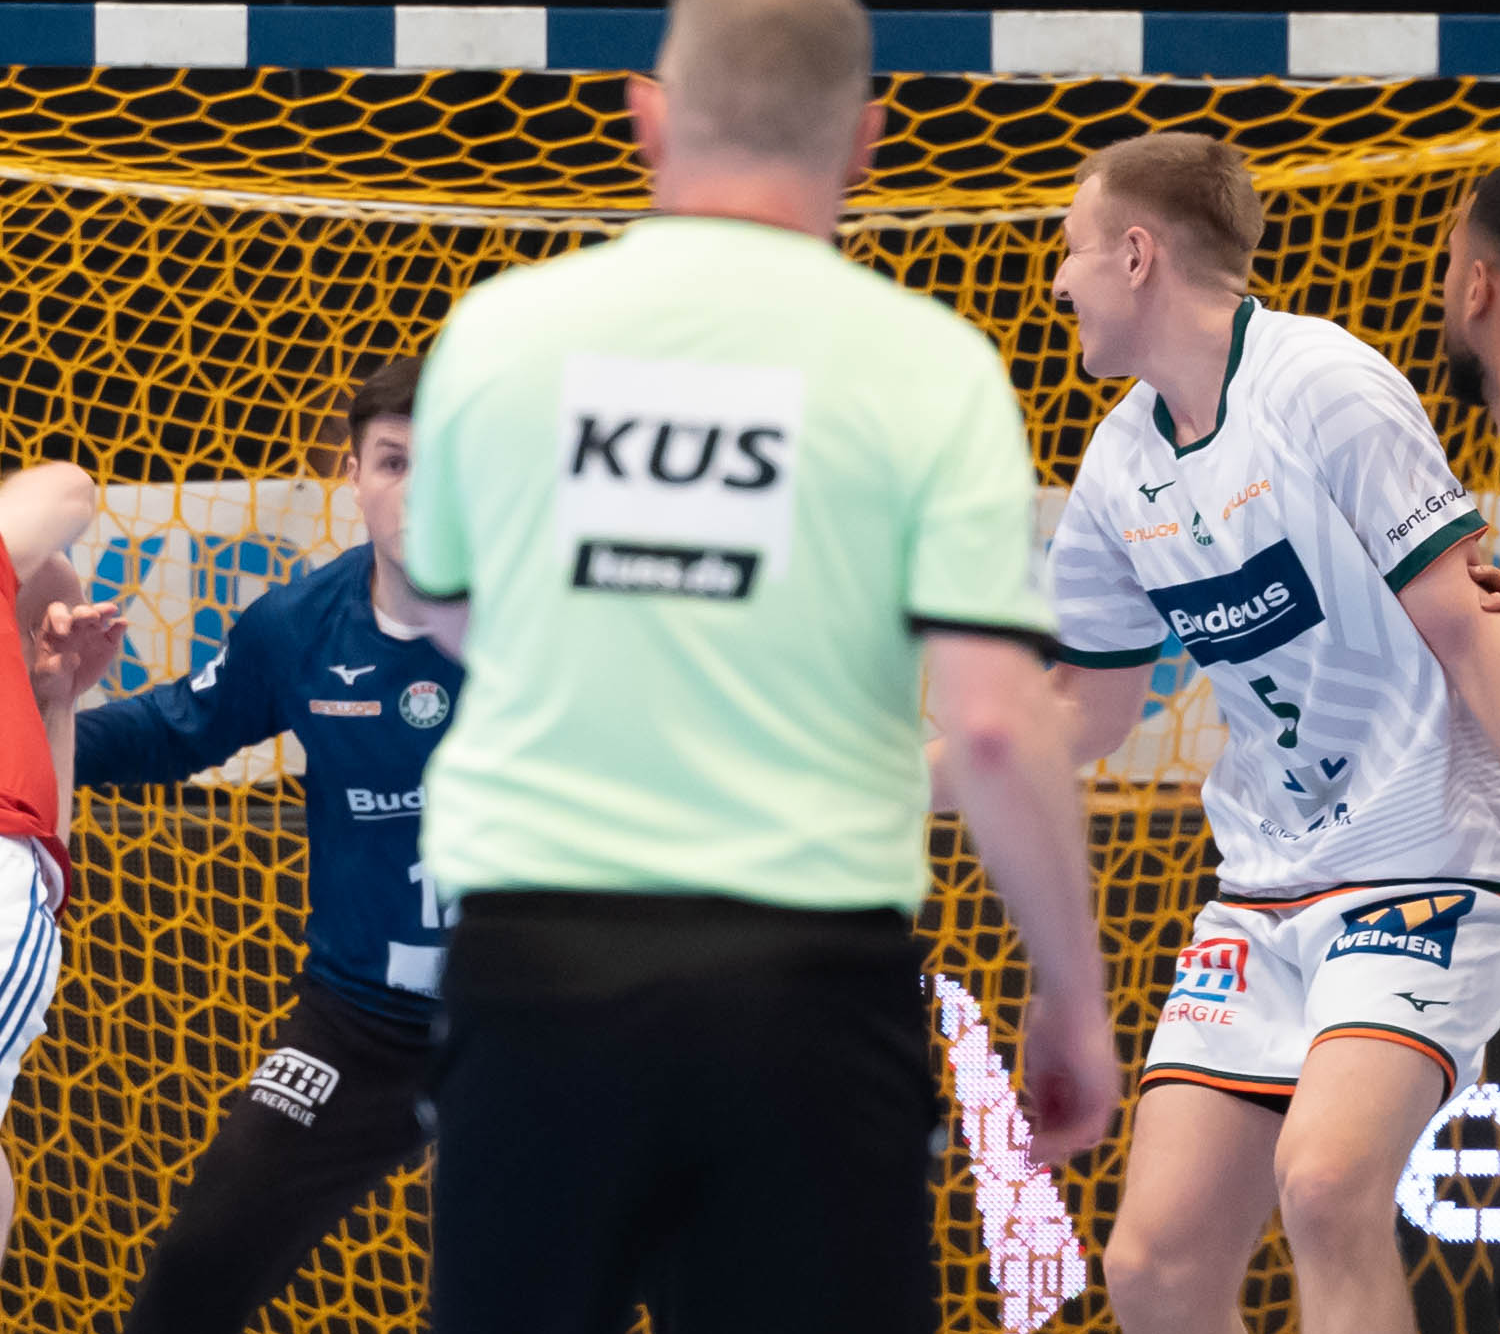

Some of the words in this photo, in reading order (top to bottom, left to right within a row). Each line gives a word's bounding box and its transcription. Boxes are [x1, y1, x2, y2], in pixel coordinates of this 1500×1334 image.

[1386, 482, 1475, 547] Rent.Grou
[1169, 582, 1290, 637] Buderus
[1248, 675, 1301, 749] 5
[1336, 929, 1444, 961] WEIMER
[1161, 1003, 1240, 1026] NERGIE
[252, 1087, 317, 1128] ENERGIE
